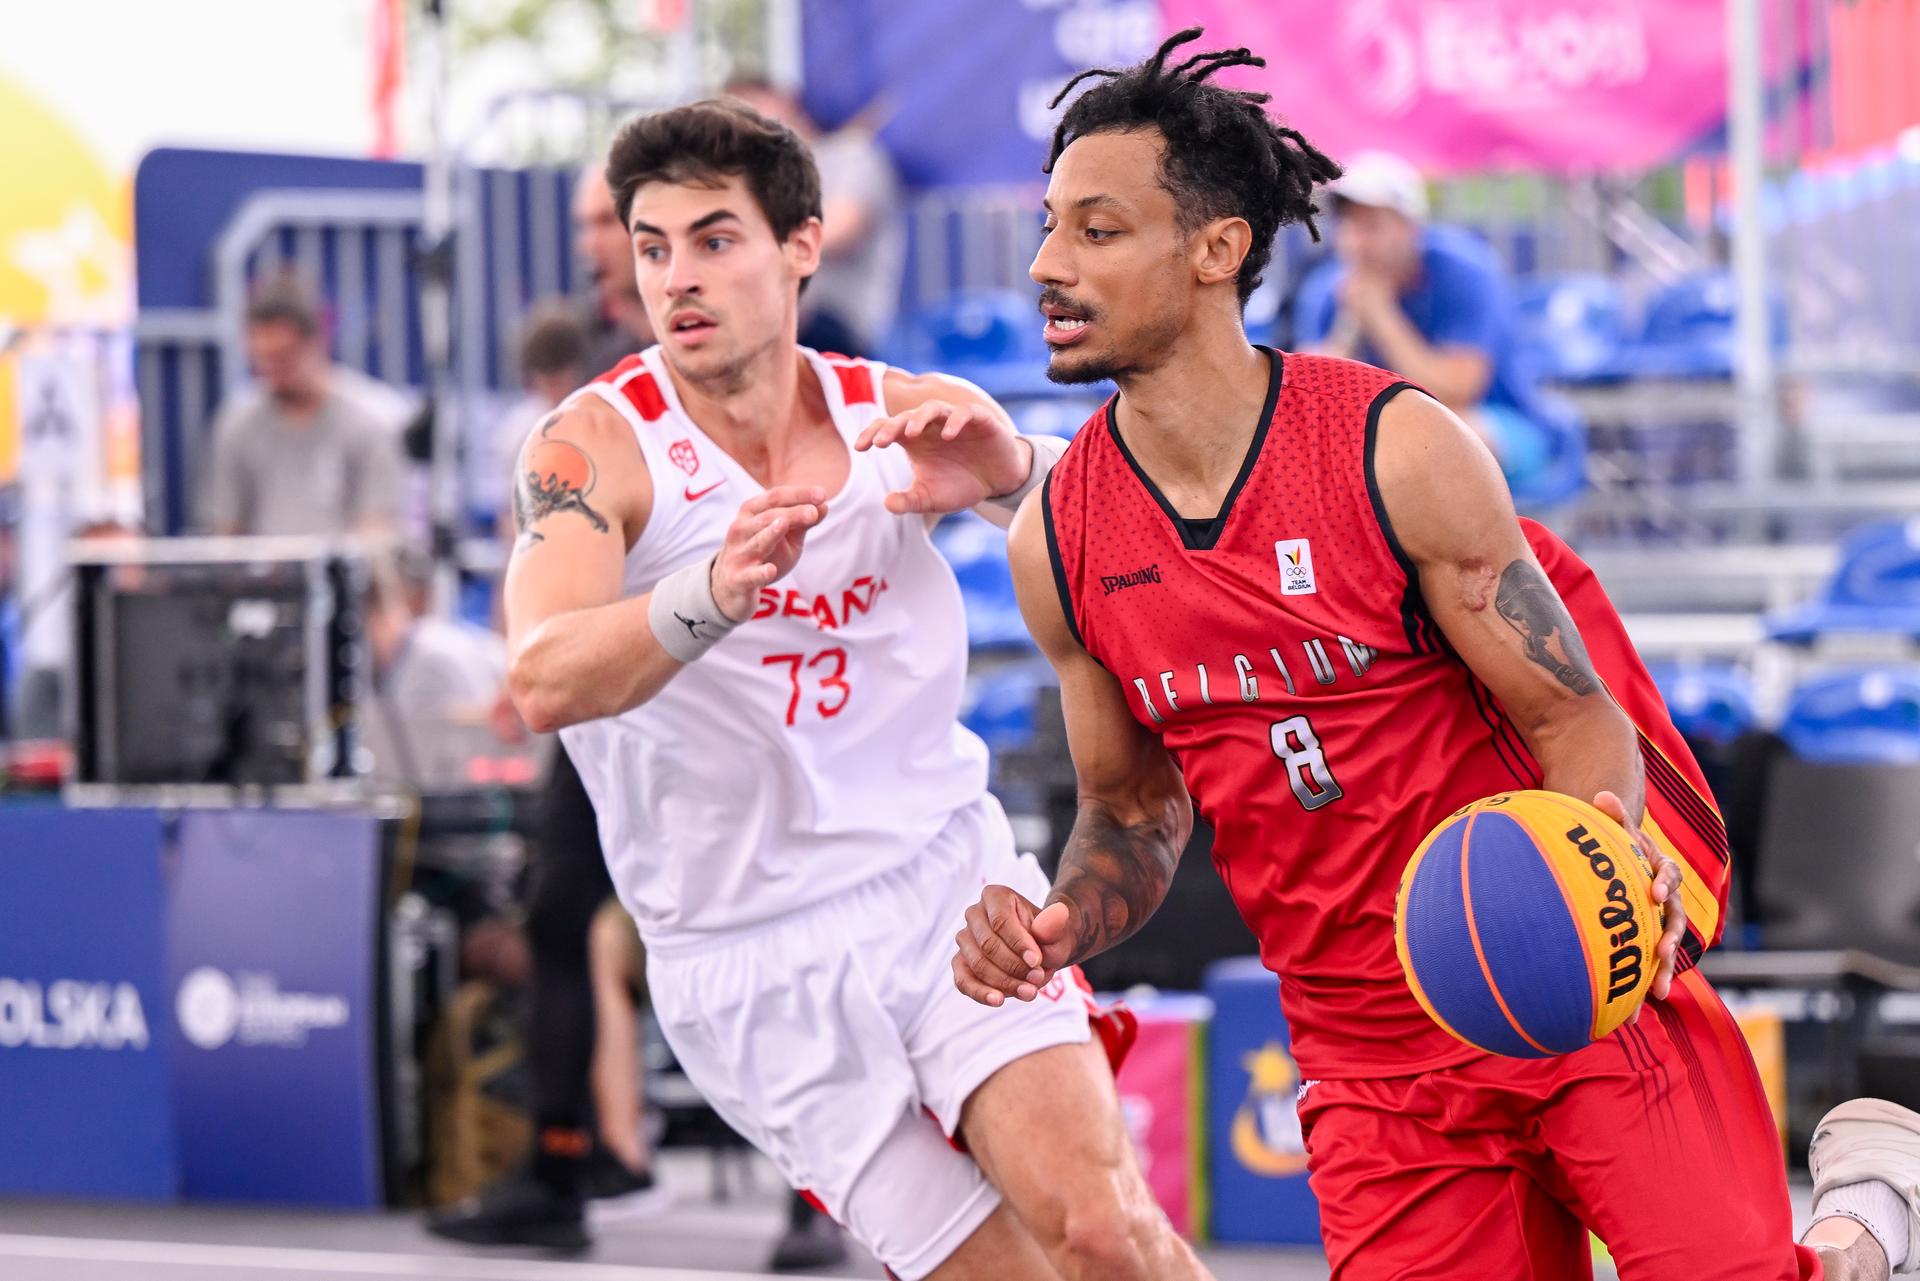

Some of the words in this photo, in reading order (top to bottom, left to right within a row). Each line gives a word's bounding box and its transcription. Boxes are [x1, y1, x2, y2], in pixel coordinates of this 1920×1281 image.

[1101, 564, 1162, 596] SPALDING
[761, 646, 852, 727] 73
[1269, 714, 1344, 812] 8
[1565, 822, 1643, 1005] Wilson
